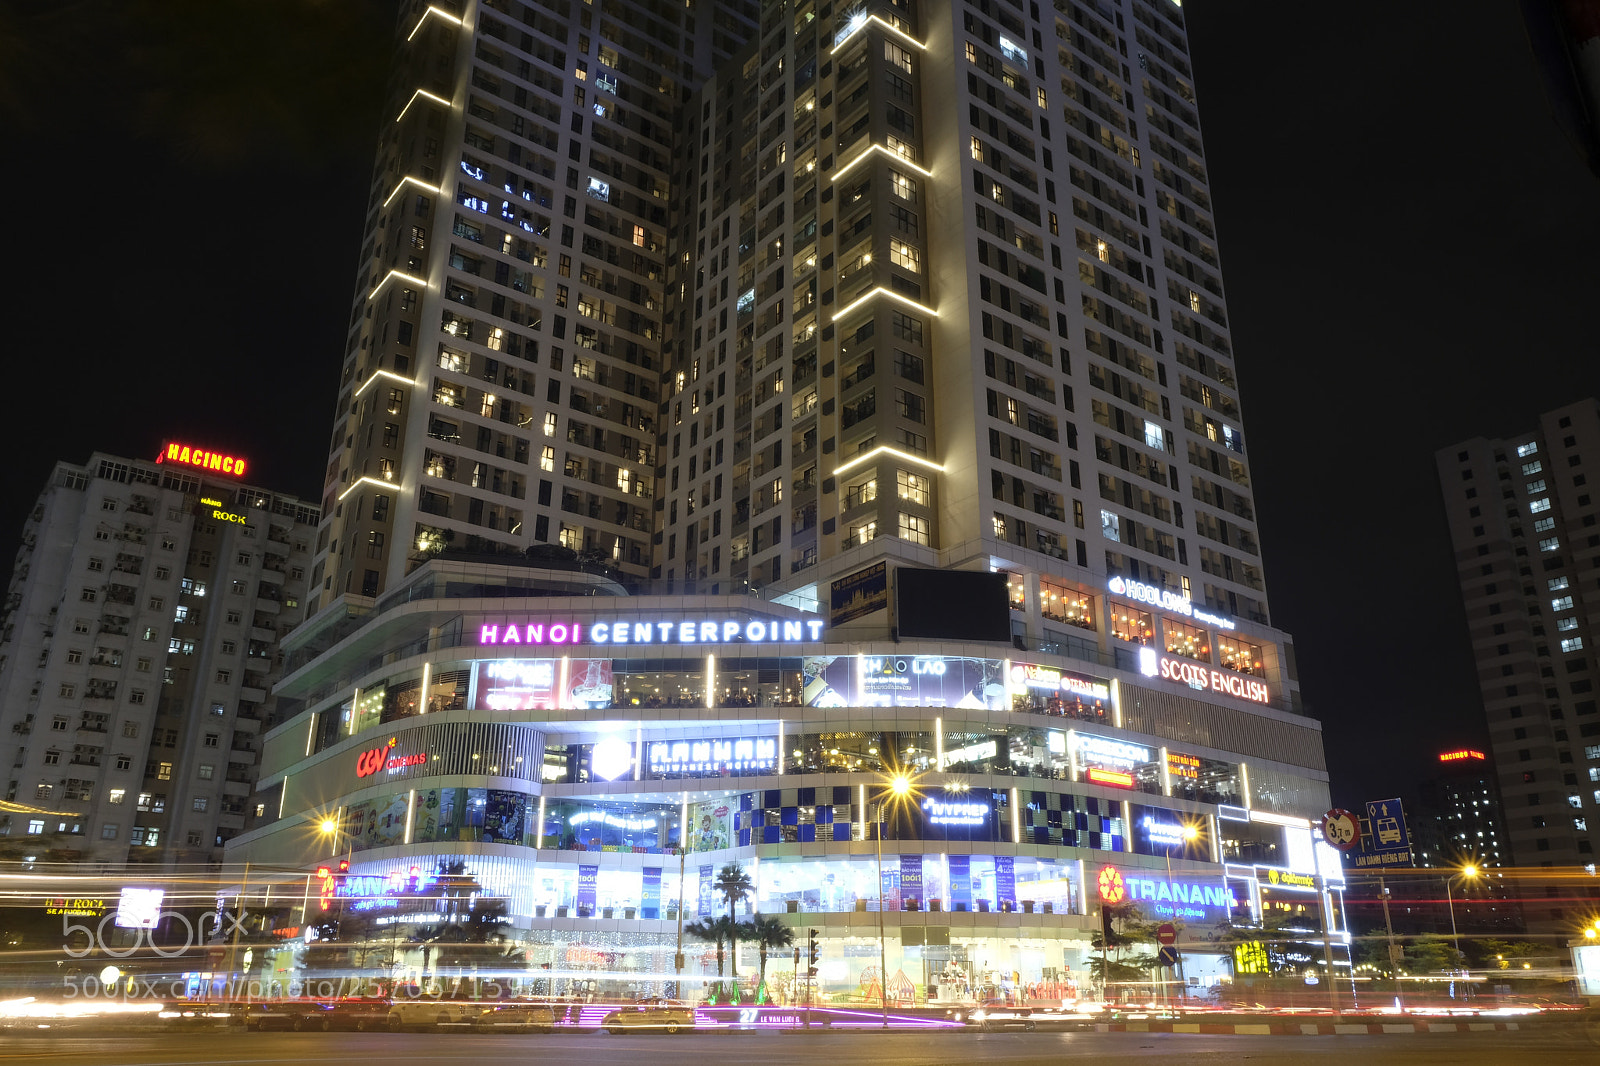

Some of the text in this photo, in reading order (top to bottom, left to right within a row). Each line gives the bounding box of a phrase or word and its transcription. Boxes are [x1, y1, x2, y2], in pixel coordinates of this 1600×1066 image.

[167, 443, 245, 475] HACINCO
[212, 510, 247, 525] ROCK
[1126, 578, 1192, 616] HOOLONG
[480, 620, 824, 644] HANOI CENTERPOINT
[1160, 657, 1270, 704] SCOTS ENGLISH
[356, 745, 389, 778] CGV
[386, 753, 426, 769] CINEMAS
[725, 759, 775, 771] HOTPOT
[1397, 851, 1409, 862] BRT
[1125, 878, 1234, 907] TRANANH
[740, 1009, 759, 1023] 27
